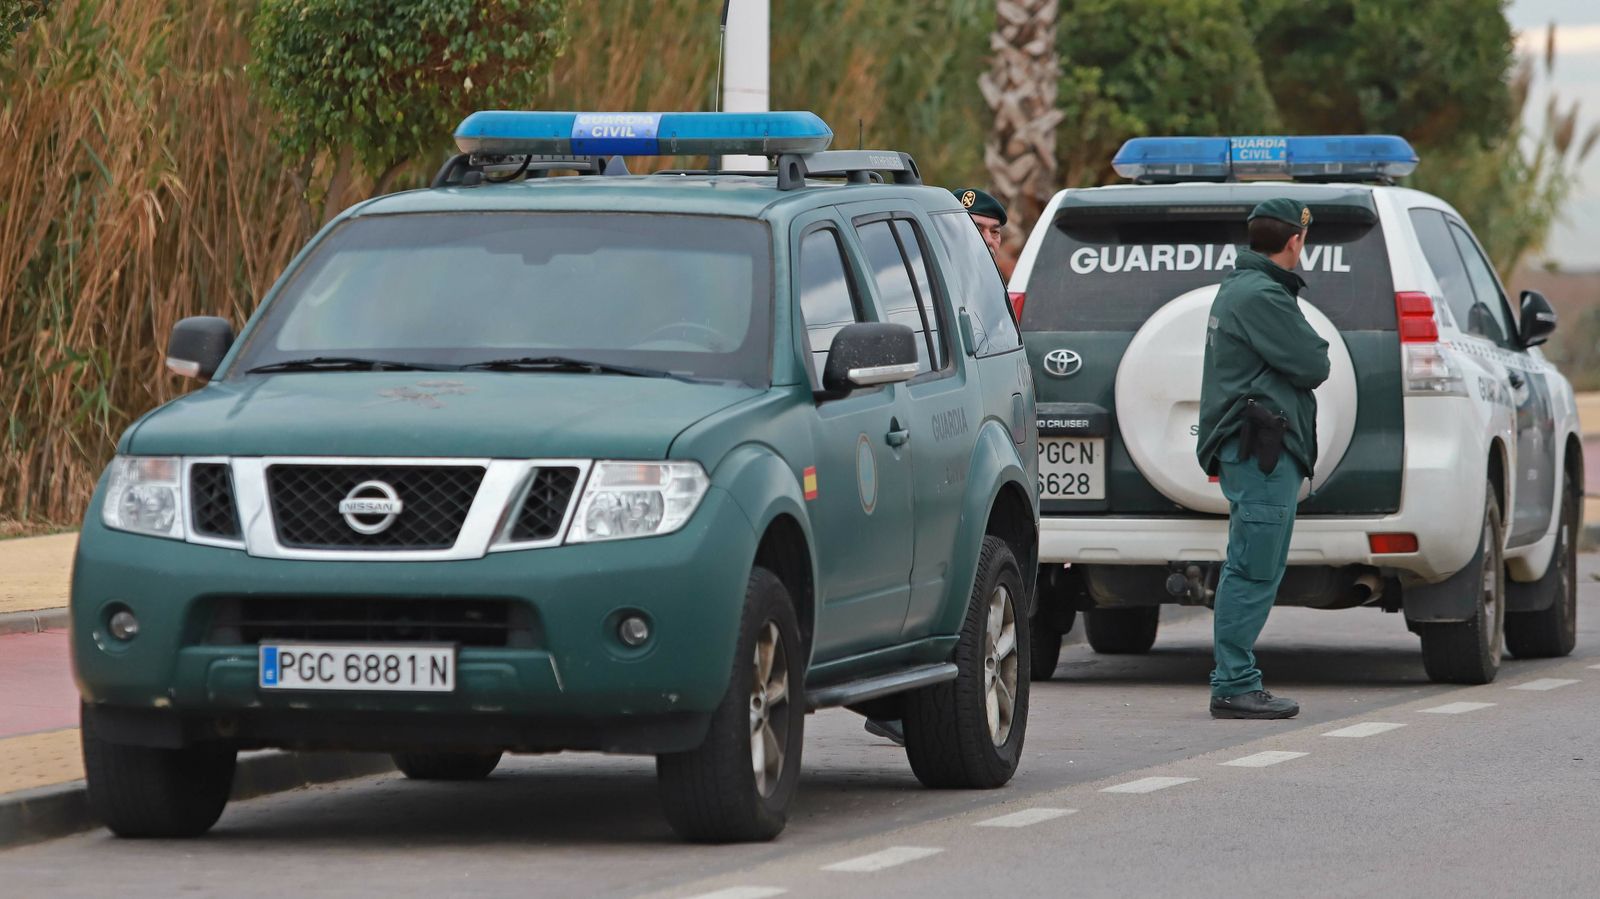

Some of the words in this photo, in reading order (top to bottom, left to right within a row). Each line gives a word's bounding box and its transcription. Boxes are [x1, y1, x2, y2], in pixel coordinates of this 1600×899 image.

[579, 115, 653, 125] GUARDIA
[591, 126, 636, 137] CIVIL
[1240, 149, 1273, 160] CIVIL
[1070, 244, 1237, 275] GUARDIA
[1300, 245, 1351, 273] VIL
[931, 407, 968, 442] GUARDIA
[1047, 420, 1089, 428] CRUISER
[345, 503, 393, 511] NISSAN
[279, 652, 334, 682] PGC
[344, 654, 416, 684] 6881
[430, 655, 447, 686] N
